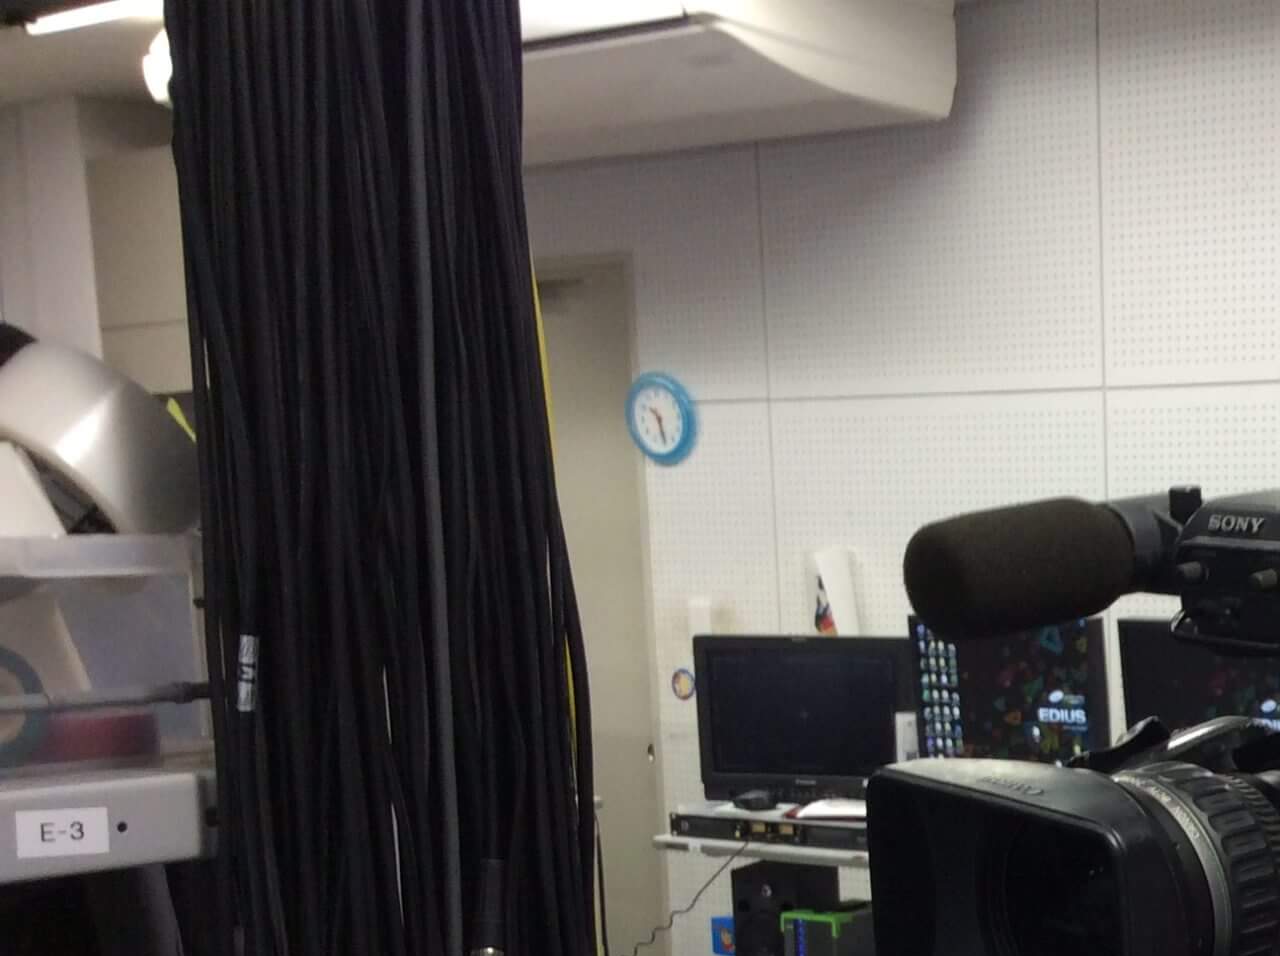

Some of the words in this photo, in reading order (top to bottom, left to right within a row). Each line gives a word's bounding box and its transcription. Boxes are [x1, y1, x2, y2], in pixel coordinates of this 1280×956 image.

[1207, 513, 1264, 534] SONY
[1038, 707, 1087, 725] EDIUS
[40, 820, 85, 842] E-3
